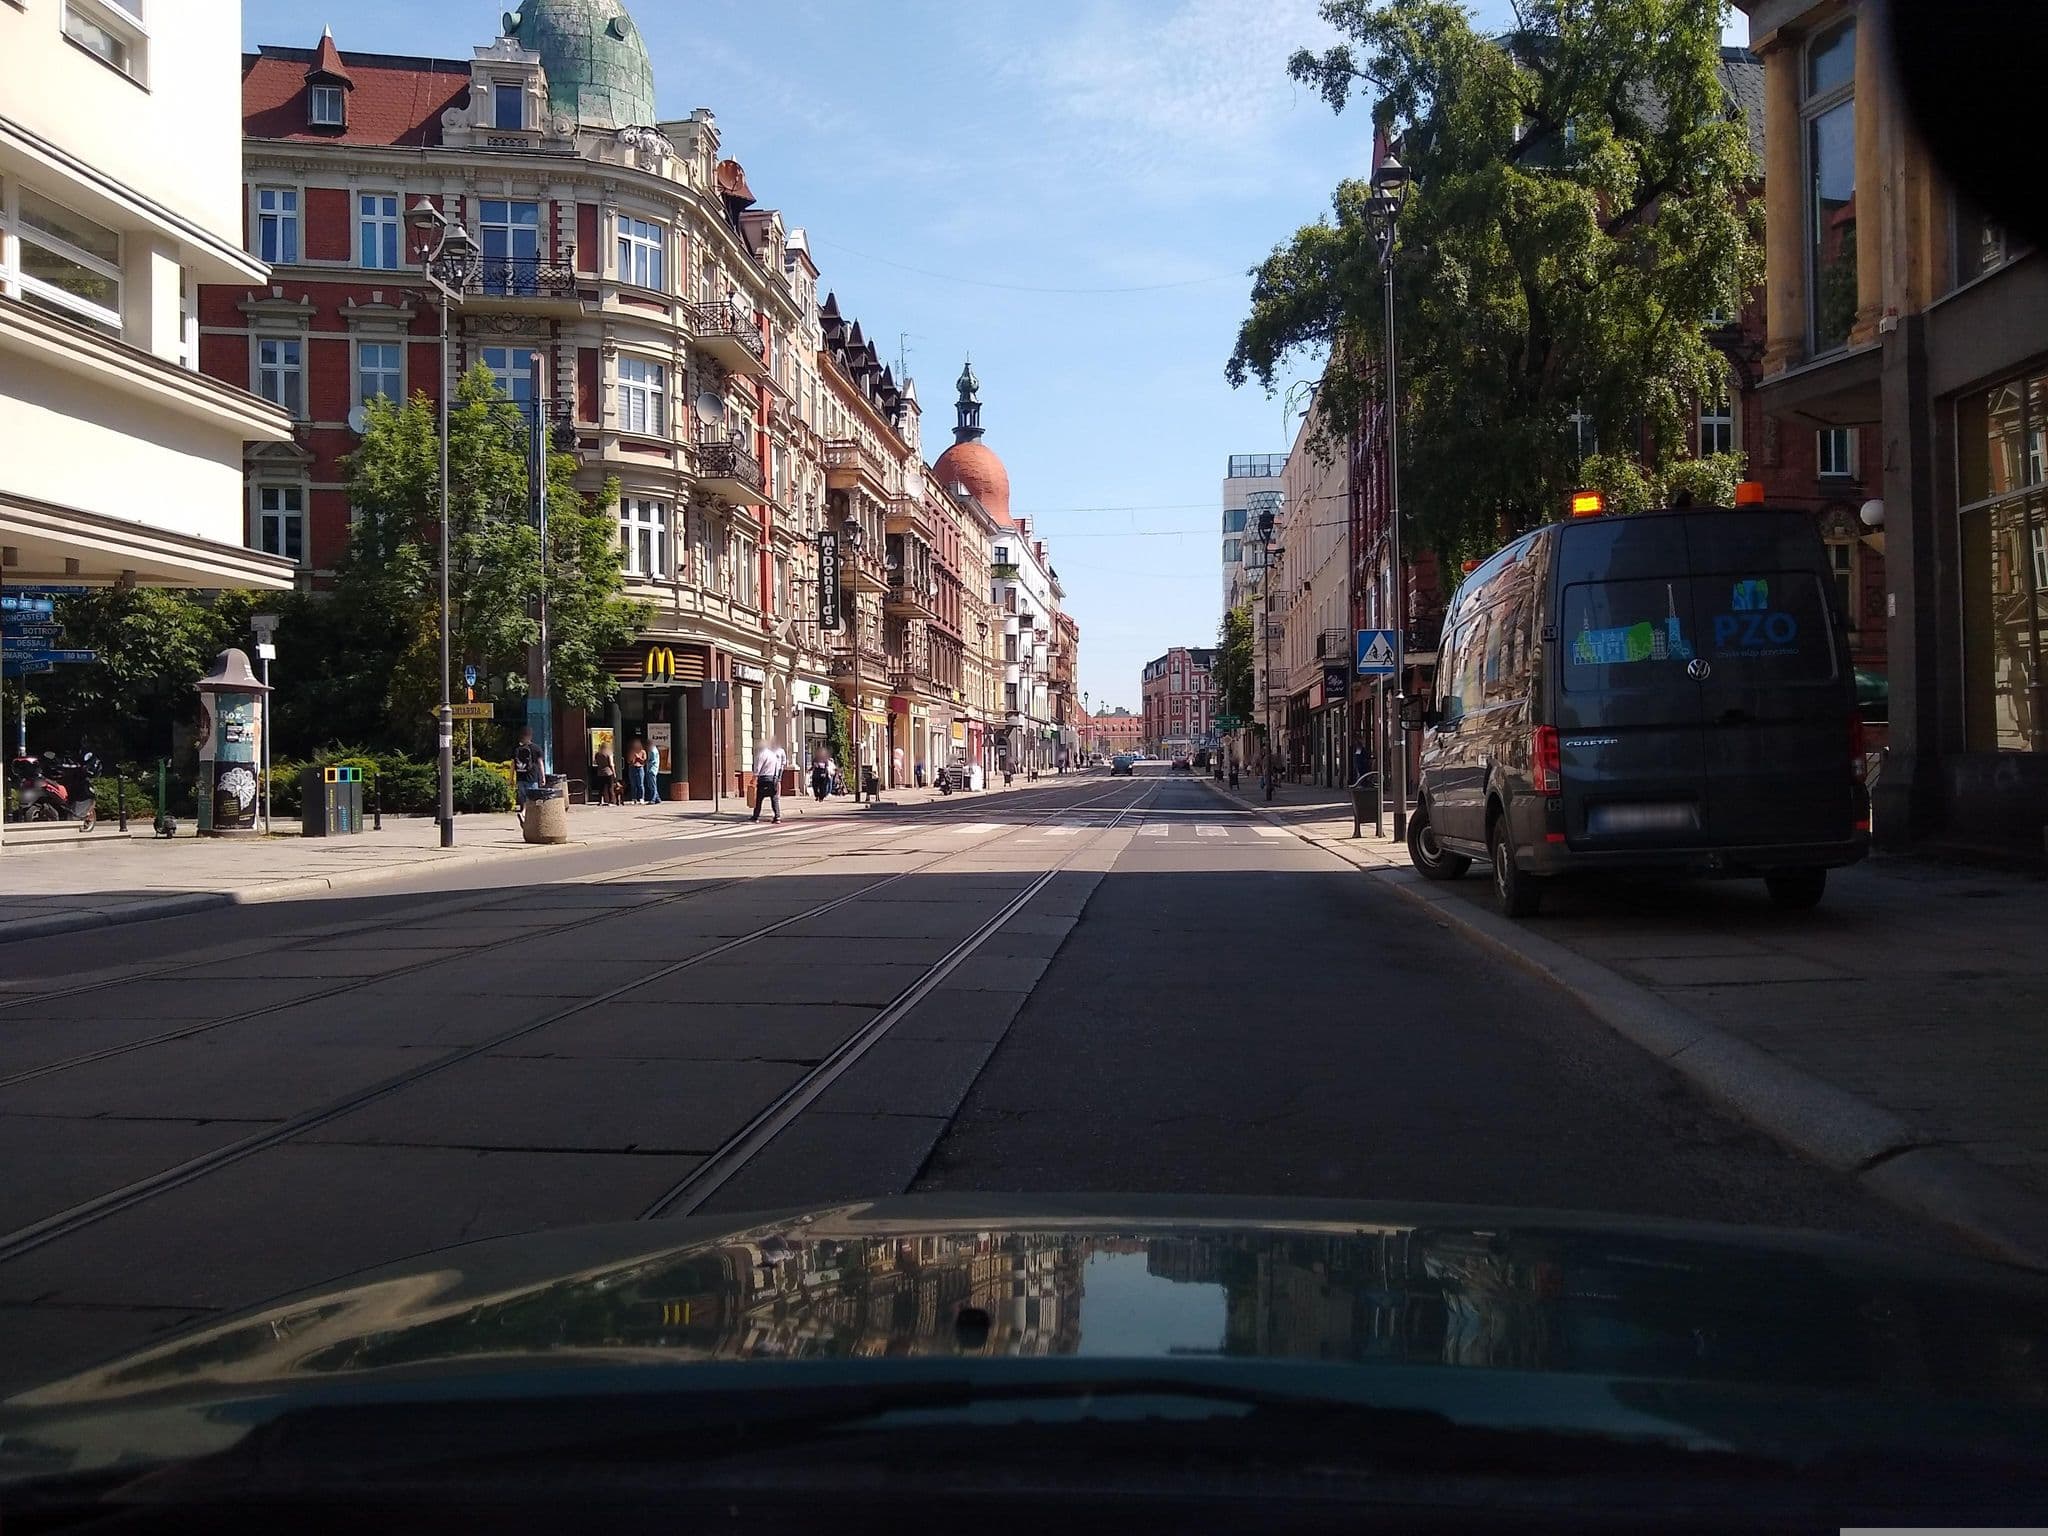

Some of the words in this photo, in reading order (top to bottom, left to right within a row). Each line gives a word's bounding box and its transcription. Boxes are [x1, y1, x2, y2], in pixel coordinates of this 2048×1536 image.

[821, 536, 836, 625] McDonald's
[22, 627, 58, 635] BOTTROP
[1714, 612, 1798, 647] PZO
[1566, 738, 1618, 747] CRAFTER
